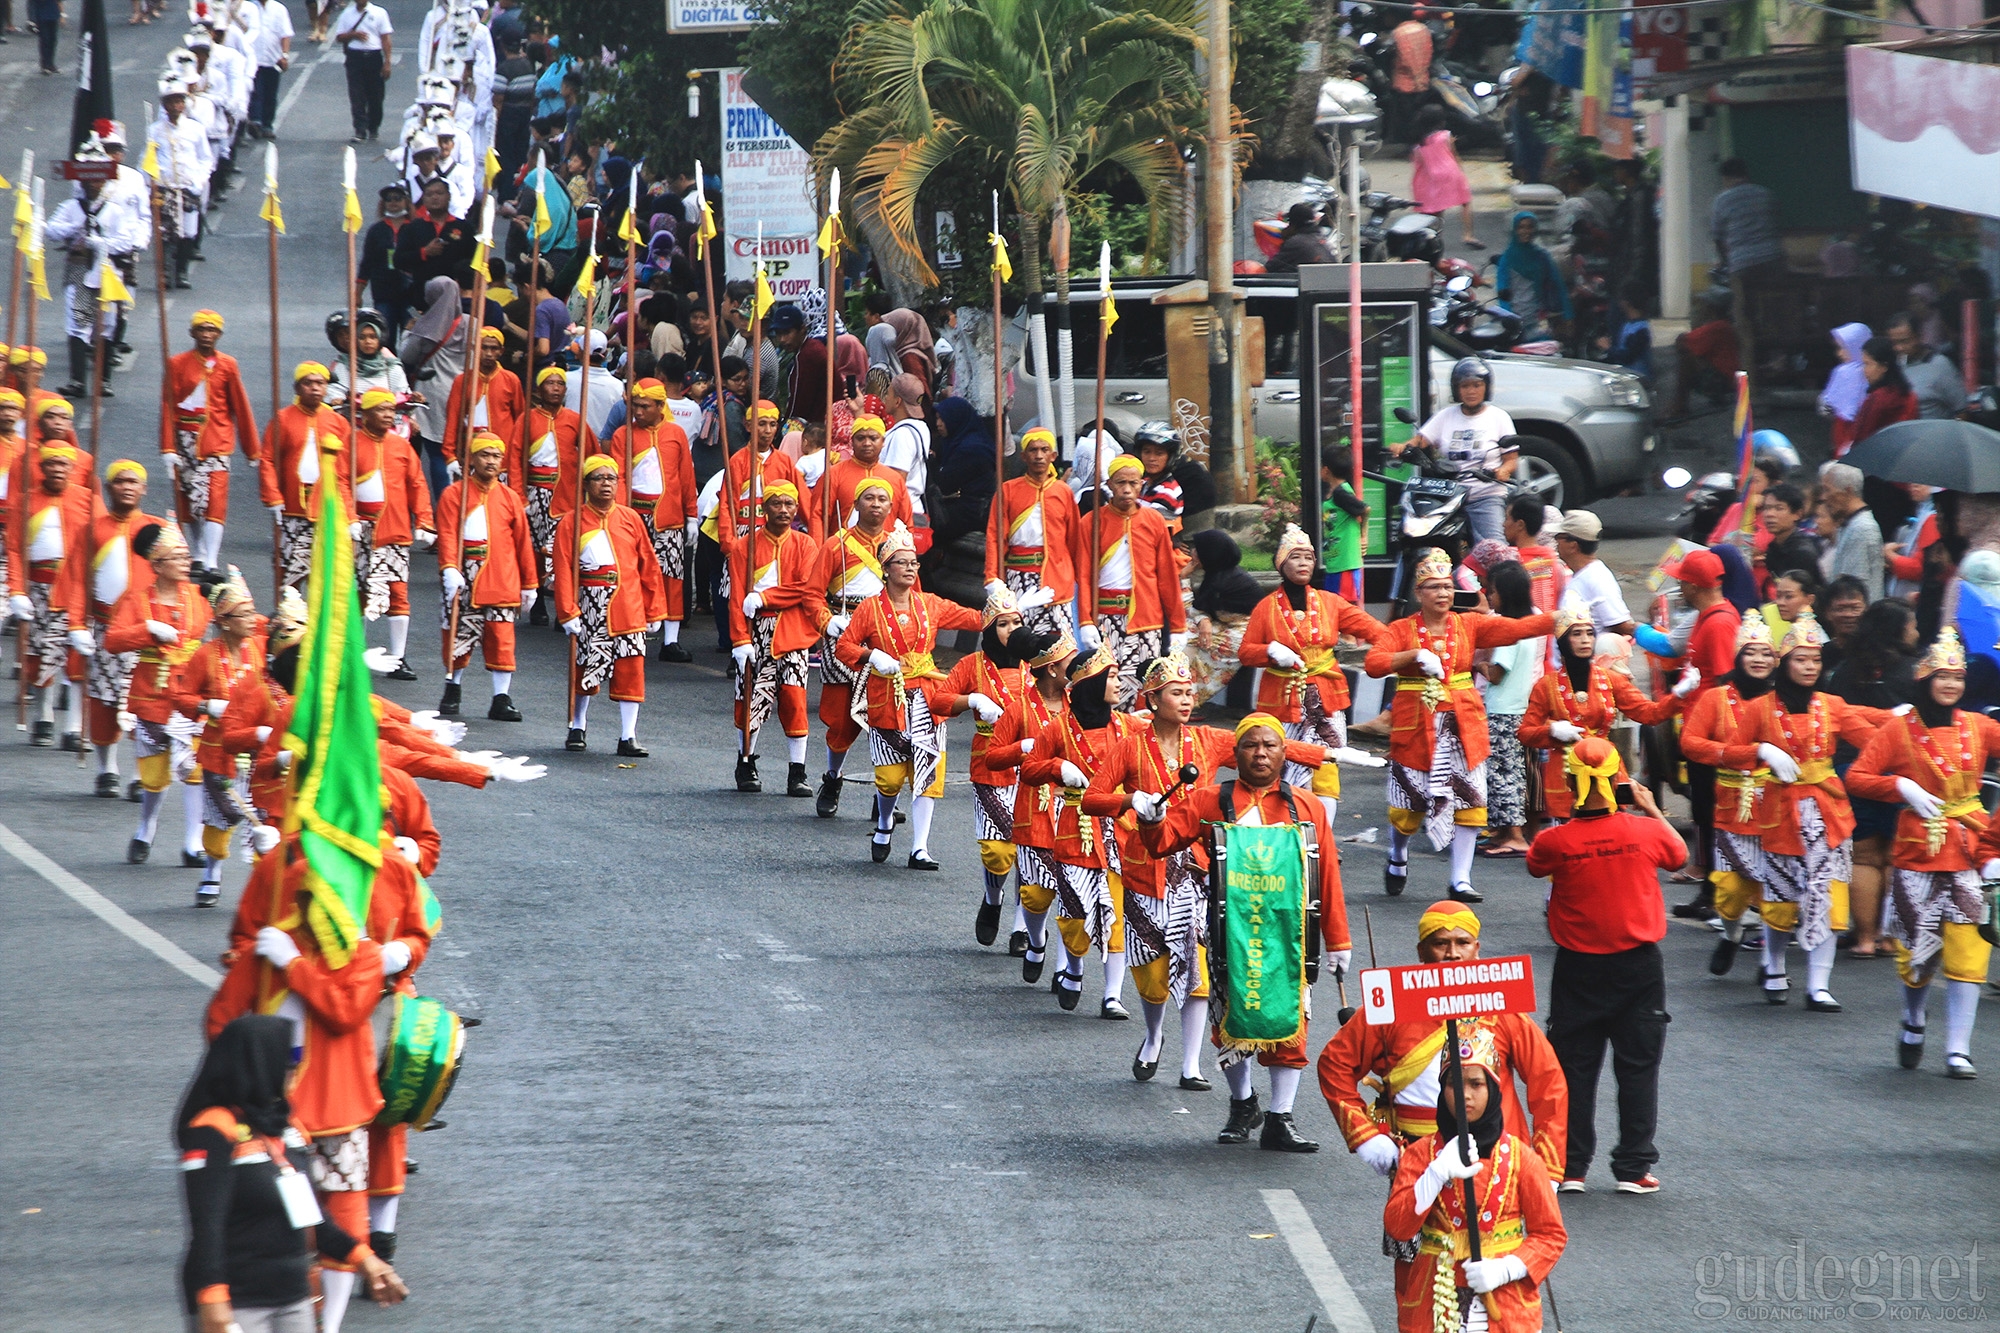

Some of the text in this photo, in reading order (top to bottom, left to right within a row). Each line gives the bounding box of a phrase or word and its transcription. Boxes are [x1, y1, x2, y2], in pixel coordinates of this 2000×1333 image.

[682, 7, 738, 23] DIGITAL
[727, 108, 768, 138] PRINT
[737, 139, 792, 151] TERSEDIA
[727, 153, 765, 168] ALAT
[734, 238, 810, 257] Canon
[780, 279, 811, 296] COPY
[1227, 870, 1286, 892] BREGODO
[1245, 893, 1265, 1011] KYAI RONGGAH
[1401, 961, 1525, 990] KYAI RONGGAH
[1371, 986, 1386, 1008] 8
[1426, 992, 1506, 1016] GAMPING
